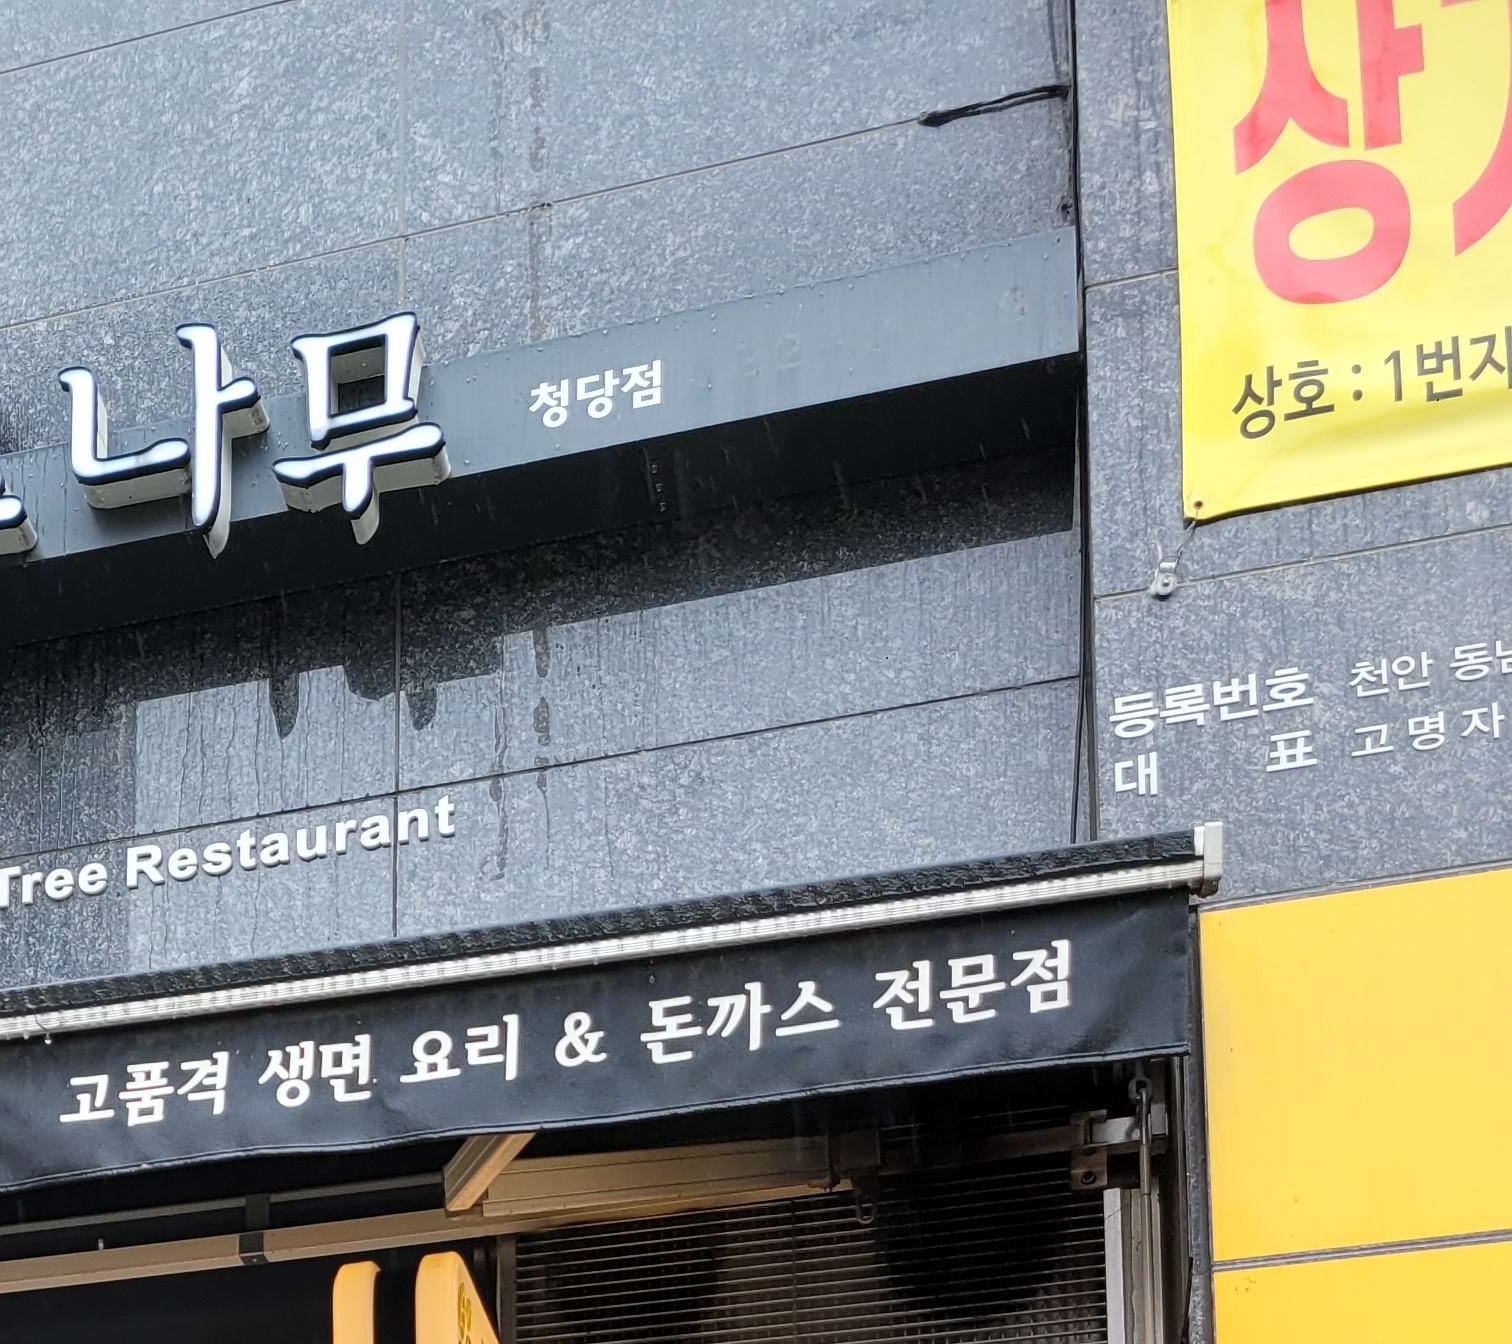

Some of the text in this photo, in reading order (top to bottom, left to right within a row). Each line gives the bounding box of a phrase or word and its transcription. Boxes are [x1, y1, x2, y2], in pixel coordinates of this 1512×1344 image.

[529, 358, 664, 429] 청당점
[1231, 360, 1336, 440] 상호
[1109, 665, 1315, 738] 등록번호
[1349, 650, 1434, 698] 천안
[1113, 749, 1160, 797] 대
[1265, 727, 1319, 773] 표
[125, 794, 458, 891] Restaurant
[58, 938, 1073, 1130] 고품격 생면 요리 & 돈까스 전문점
